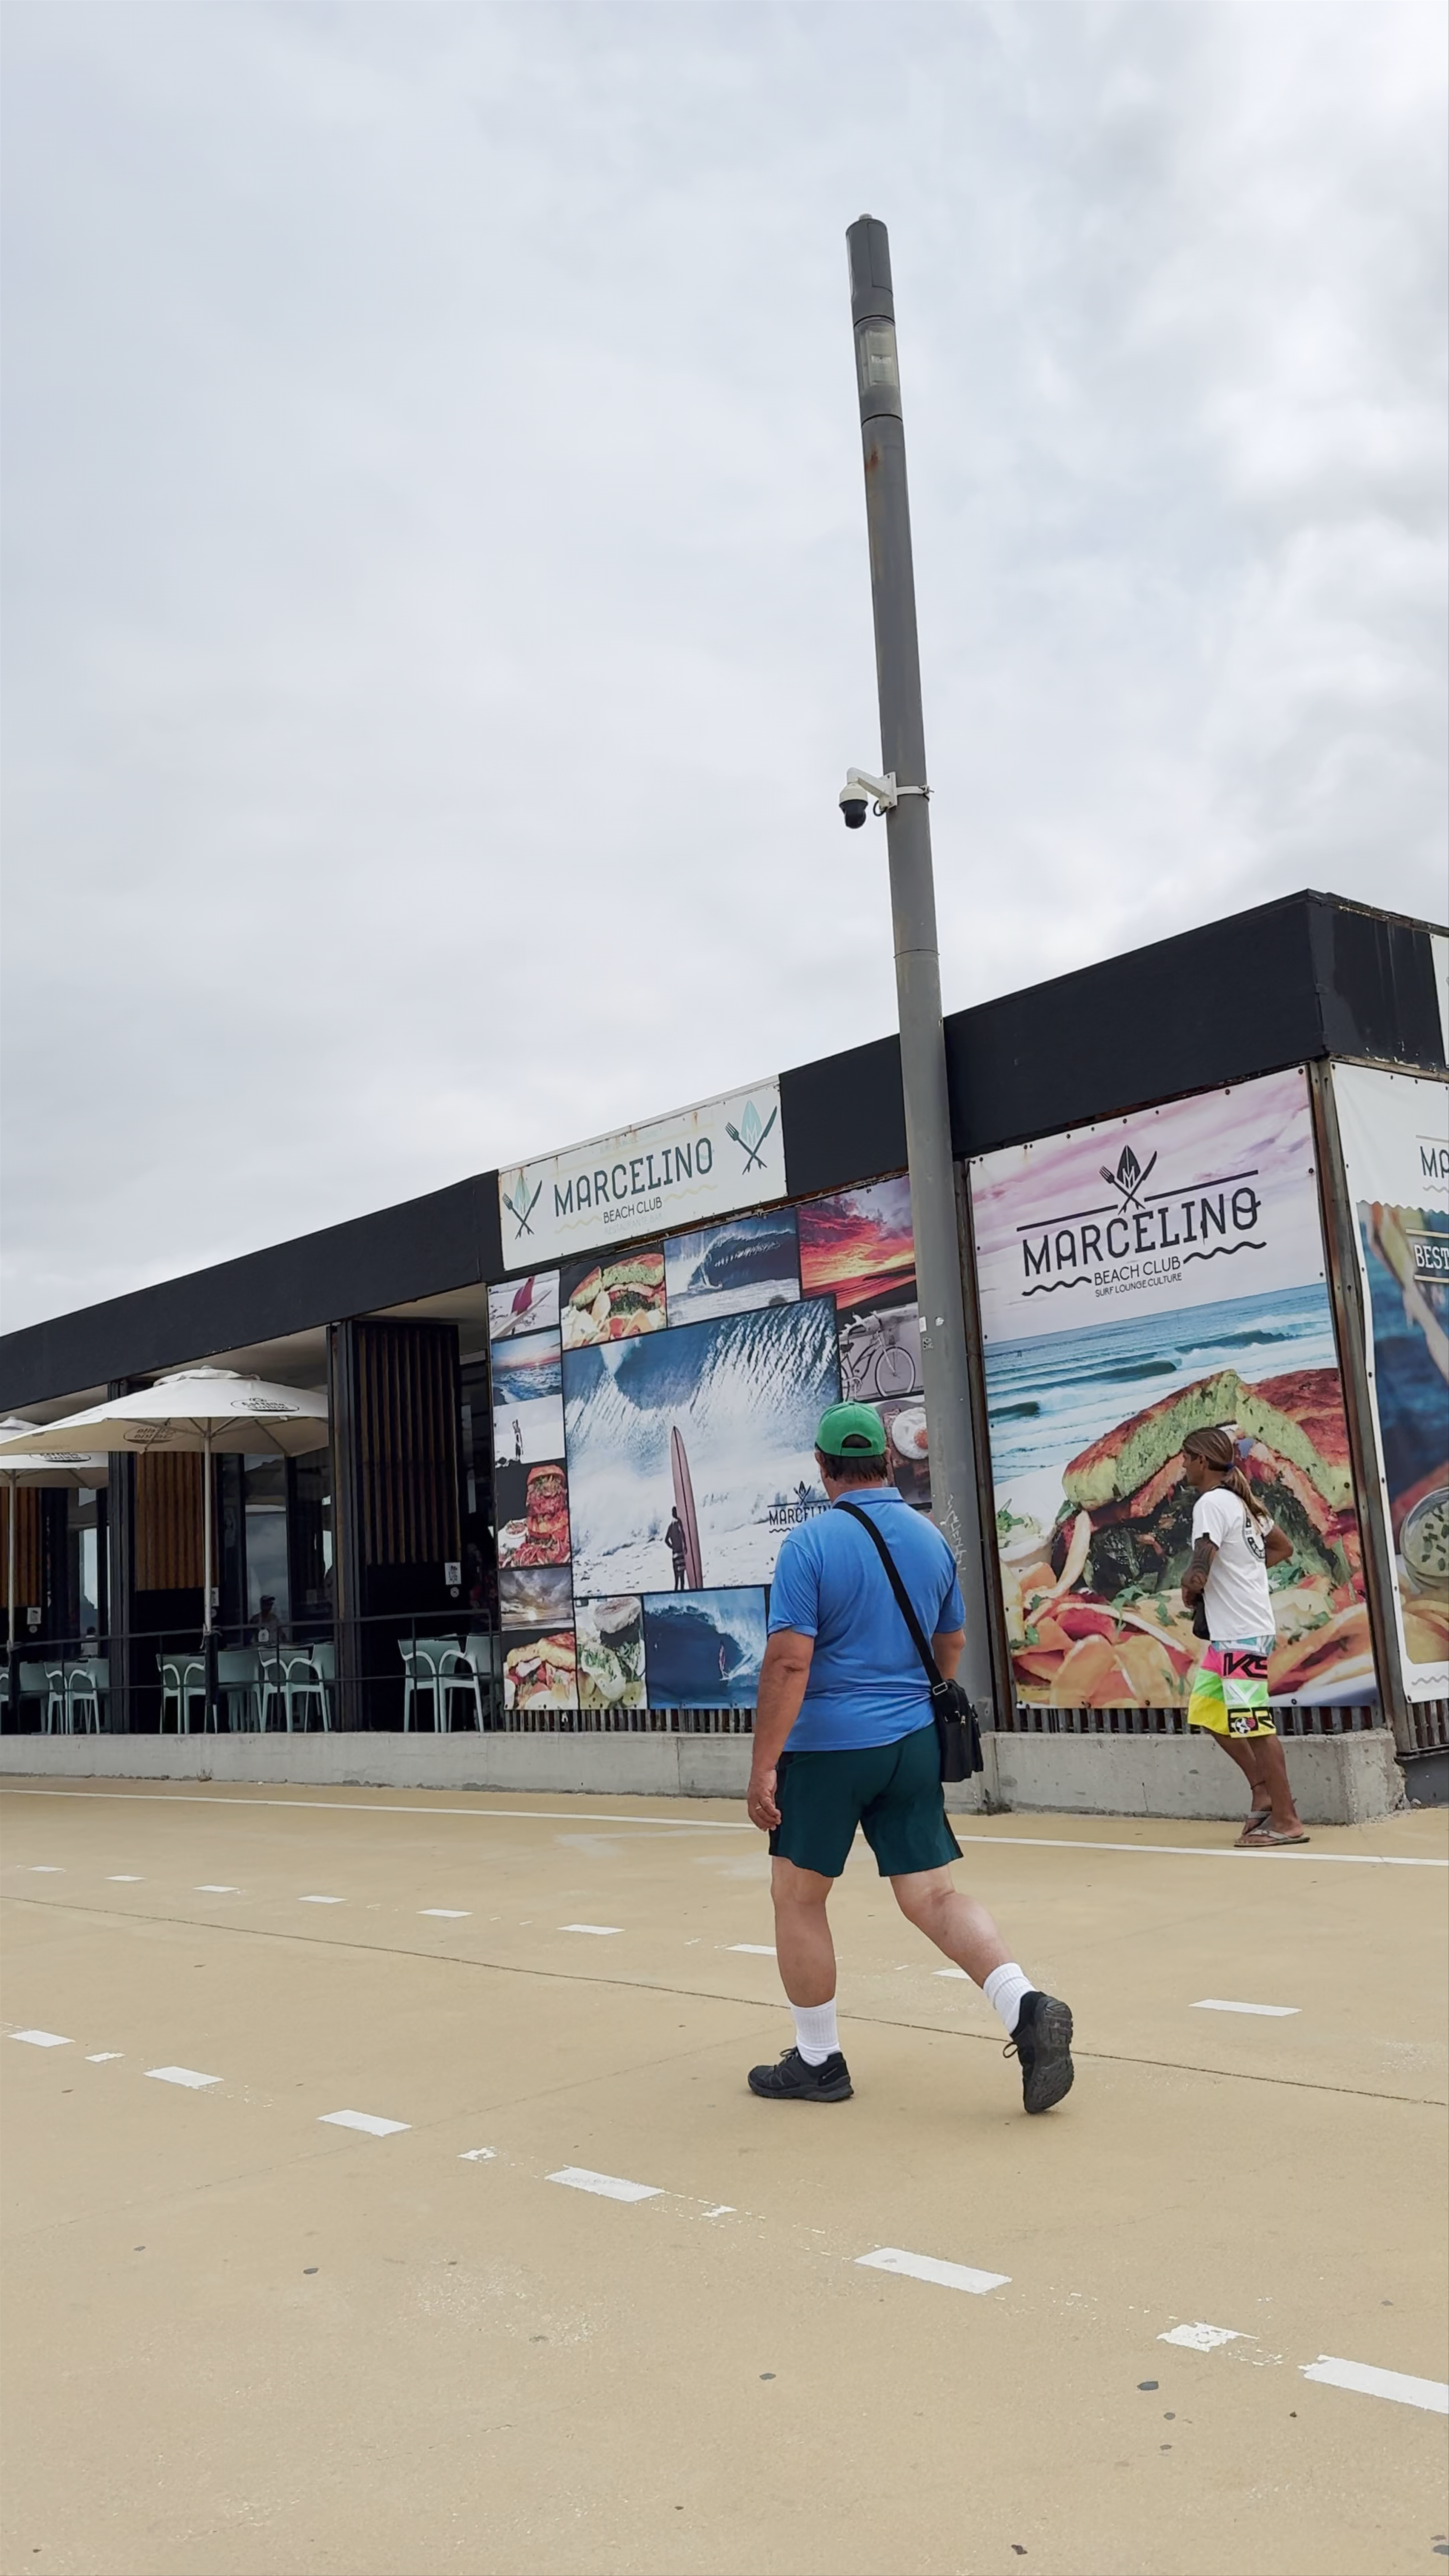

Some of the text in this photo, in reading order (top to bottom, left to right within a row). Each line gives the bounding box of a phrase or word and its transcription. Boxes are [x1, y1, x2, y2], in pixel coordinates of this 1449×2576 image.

[555, 1137, 712, 1217] MARCELINO
[603, 1196, 662, 1224] BEACH CLUB
[1022, 1187, 1261, 1277] MARCELINO
[1094, 1256, 1181, 1286] BEACH CLUB
[1414, 1244, 1449, 1270] BEST
[1095, 1272, 1182, 1297] SURF LOUNGE CULTURE
